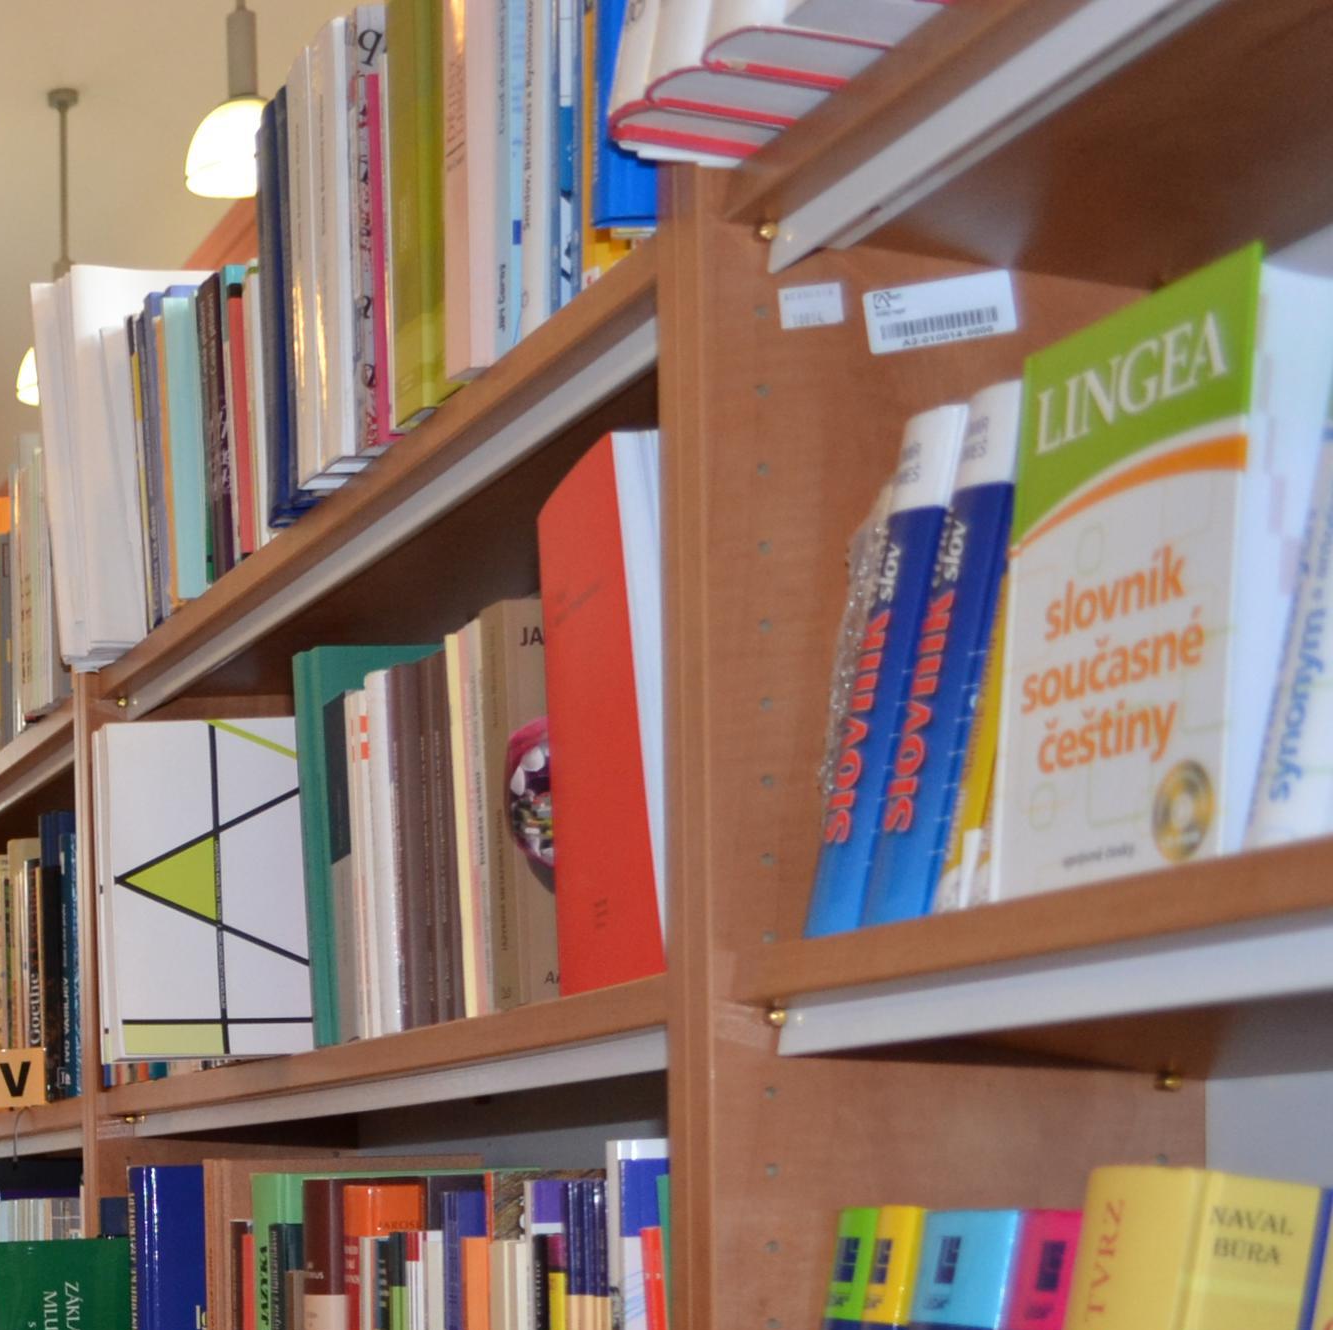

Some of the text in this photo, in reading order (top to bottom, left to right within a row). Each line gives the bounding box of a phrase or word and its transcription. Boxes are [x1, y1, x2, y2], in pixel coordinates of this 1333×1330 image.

[1034, 312, 1229, 456] LINGEA
[1044, 545, 1185, 643] slovník
[1021, 608, 1206, 714] současné
[1036, 704, 1177, 775] češtiny
[0, 1062, 31, 1096] V
[1084, 1199, 1126, 1330] TVRZ
